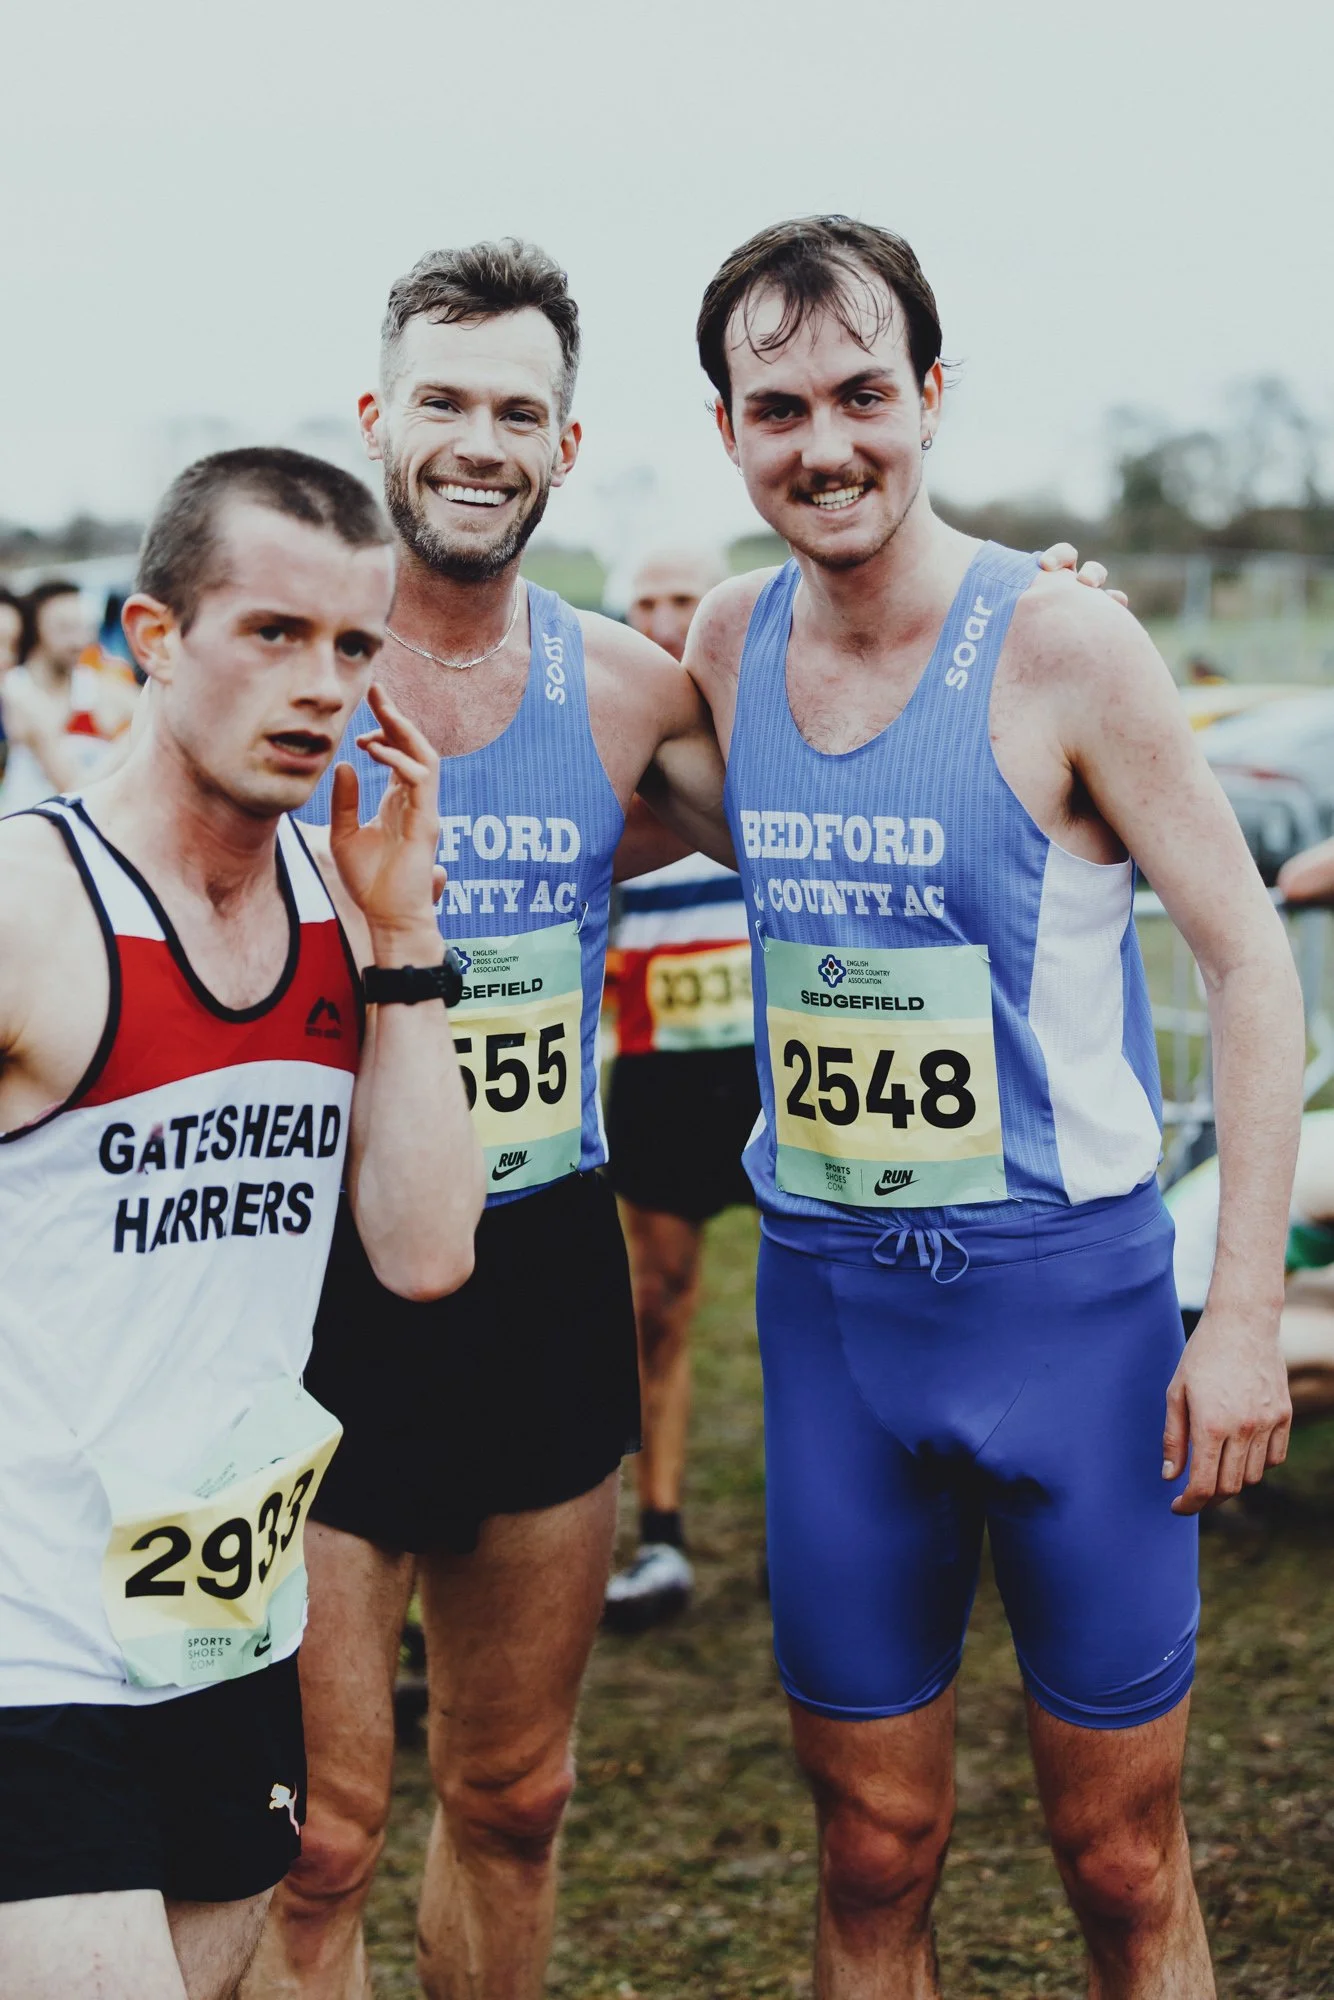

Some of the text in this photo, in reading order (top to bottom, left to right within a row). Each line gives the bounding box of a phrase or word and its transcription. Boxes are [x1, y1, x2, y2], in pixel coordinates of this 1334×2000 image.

[945, 595, 993, 691] soar
[542, 632, 566, 705] soar
[740, 809, 945, 867] BEDFORD
[529, 880, 577, 914] AC
[767, 877, 893, 916] COUNTY
[904, 884, 945, 919] AC
[472, 949, 497, 957] ENGLISH
[492, 956, 519, 964] COUNTRY
[472, 965, 511, 973] ASSOCIATION
[847, 968, 890, 977] CROSS COUNTRY
[848, 977, 882, 985] ASSOCIATION
[800, 989, 925, 1011] SEDGEFIELD
[783, 1038, 977, 1129] 2548
[99, 1103, 342, 1176] GATESHEAD
[498, 1150, 528, 1168] RUN
[825, 1163, 850, 1174] SPORTS
[881, 1169, 914, 1184] RUN
[825, 1172, 847, 1184] SHOES
[113, 1181, 315, 1254] HARRERS
[125, 1467, 315, 1600] 2933
[188, 1637, 231, 1647] SPORTS
[188, 1648, 223, 1659] SHOES
